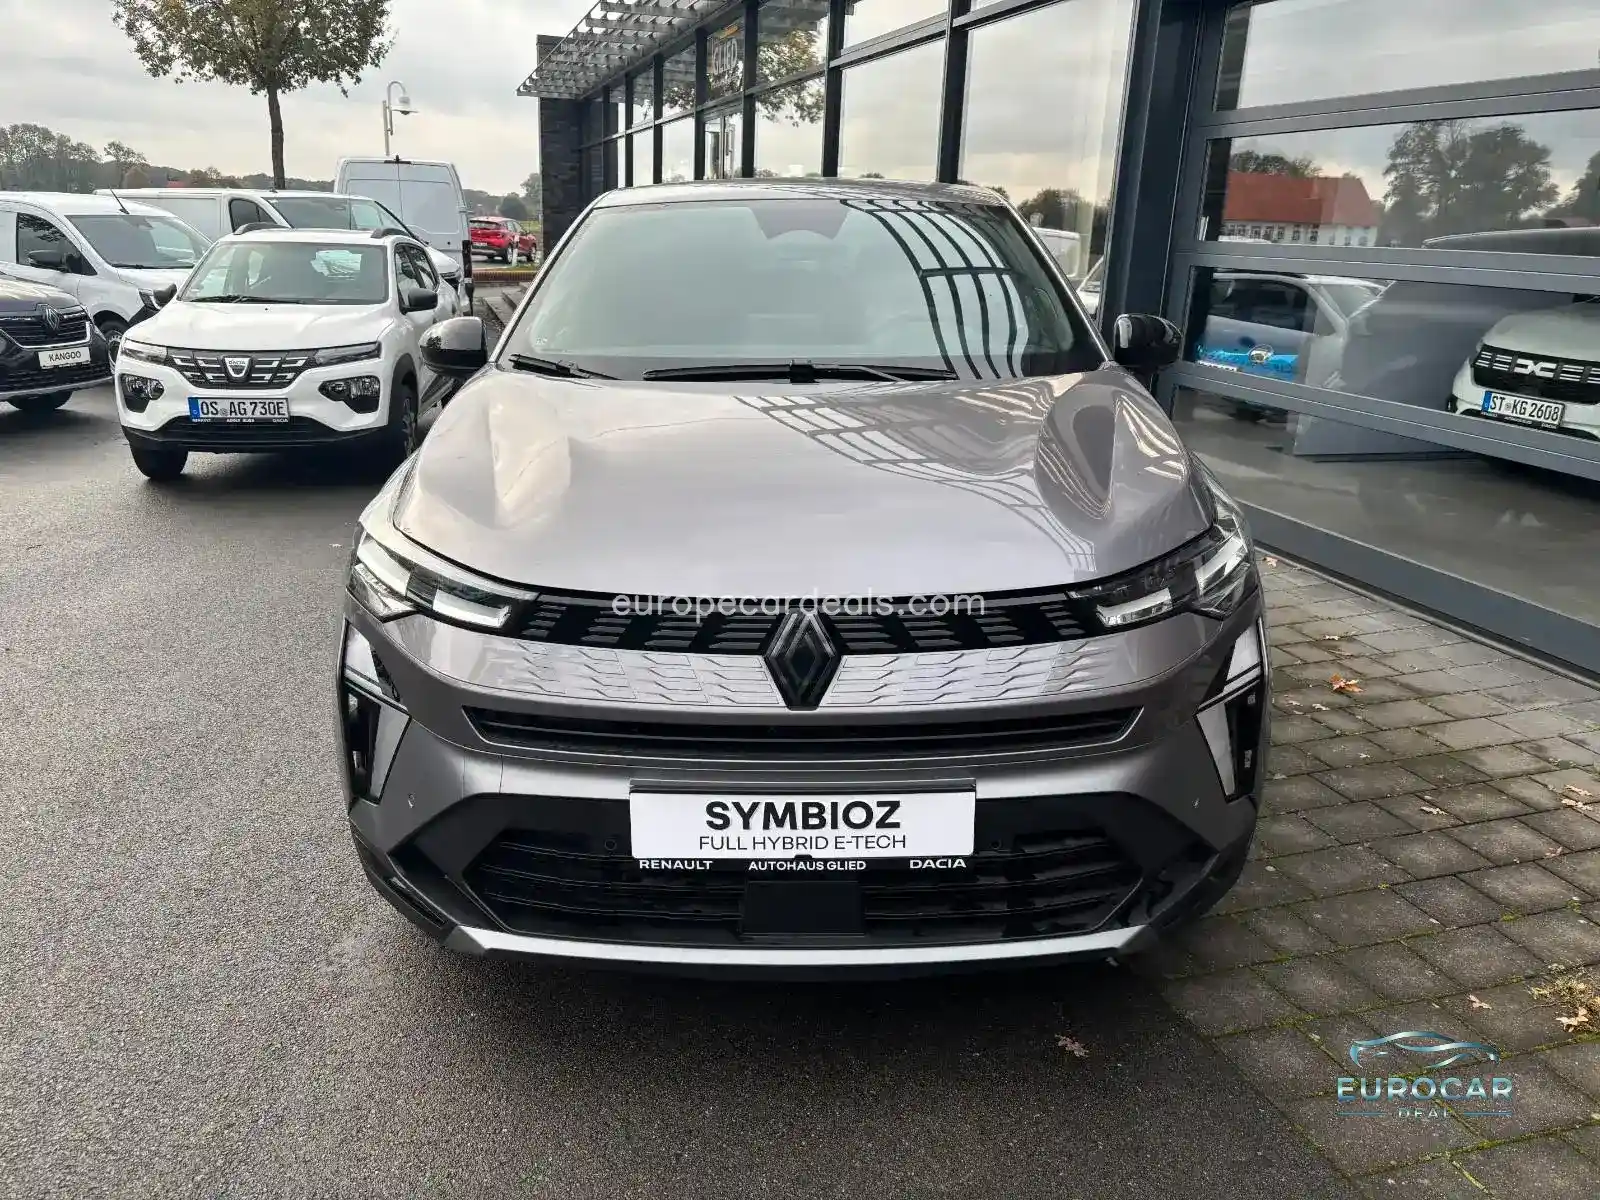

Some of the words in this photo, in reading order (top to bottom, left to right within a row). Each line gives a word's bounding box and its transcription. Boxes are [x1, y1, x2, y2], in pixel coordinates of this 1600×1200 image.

[200, 401, 219, 416] OS
[1490, 395, 1505, 411] ST
[1511, 399, 1528, 416] KG
[705, 800, 901, 830] SYMBIOZ
[699, 836, 747, 850] FULL
[752, 836, 829, 850] HYBRID
[834, 835, 906, 849] E-TECH
[639, 860, 713, 870] RENAULT
[748, 861, 825, 871] AUTOHAUS
[826, 861, 867, 871] GLIED
[909, 859, 967, 869] DACIA
